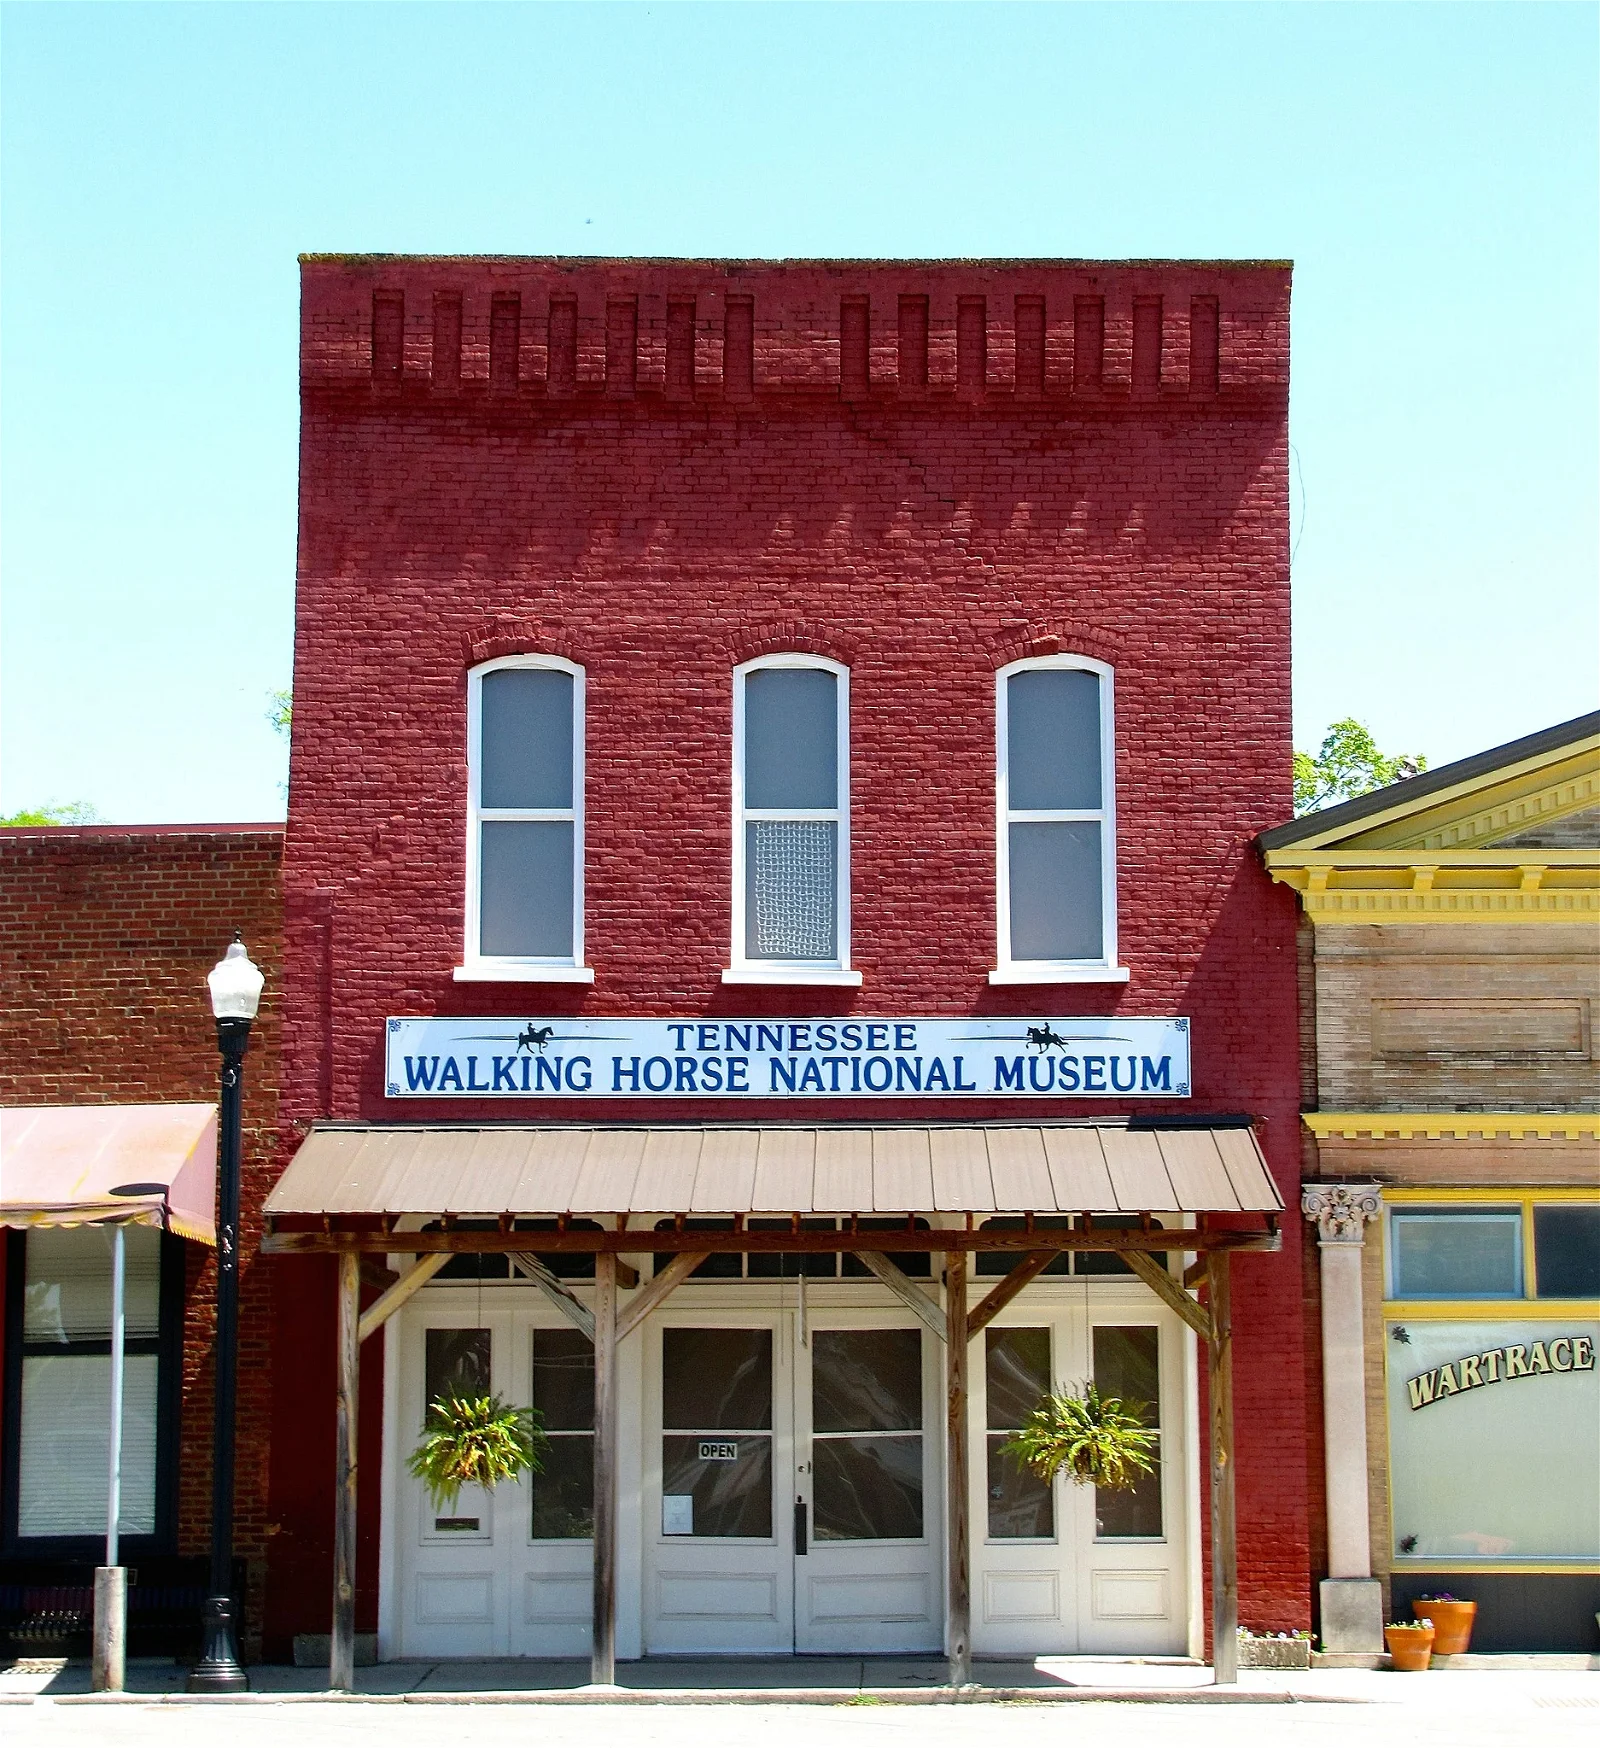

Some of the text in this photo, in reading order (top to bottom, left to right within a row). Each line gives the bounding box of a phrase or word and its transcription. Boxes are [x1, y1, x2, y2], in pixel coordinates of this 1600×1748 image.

[667, 1024, 917, 1051] TENNESSEE
[404, 1056, 1172, 1091] WALKING HORSE NATIONAL MUSEUM
[1406, 1336, 1596, 1411] WARTRACE
[700, 1444, 735, 1458] OPEN
